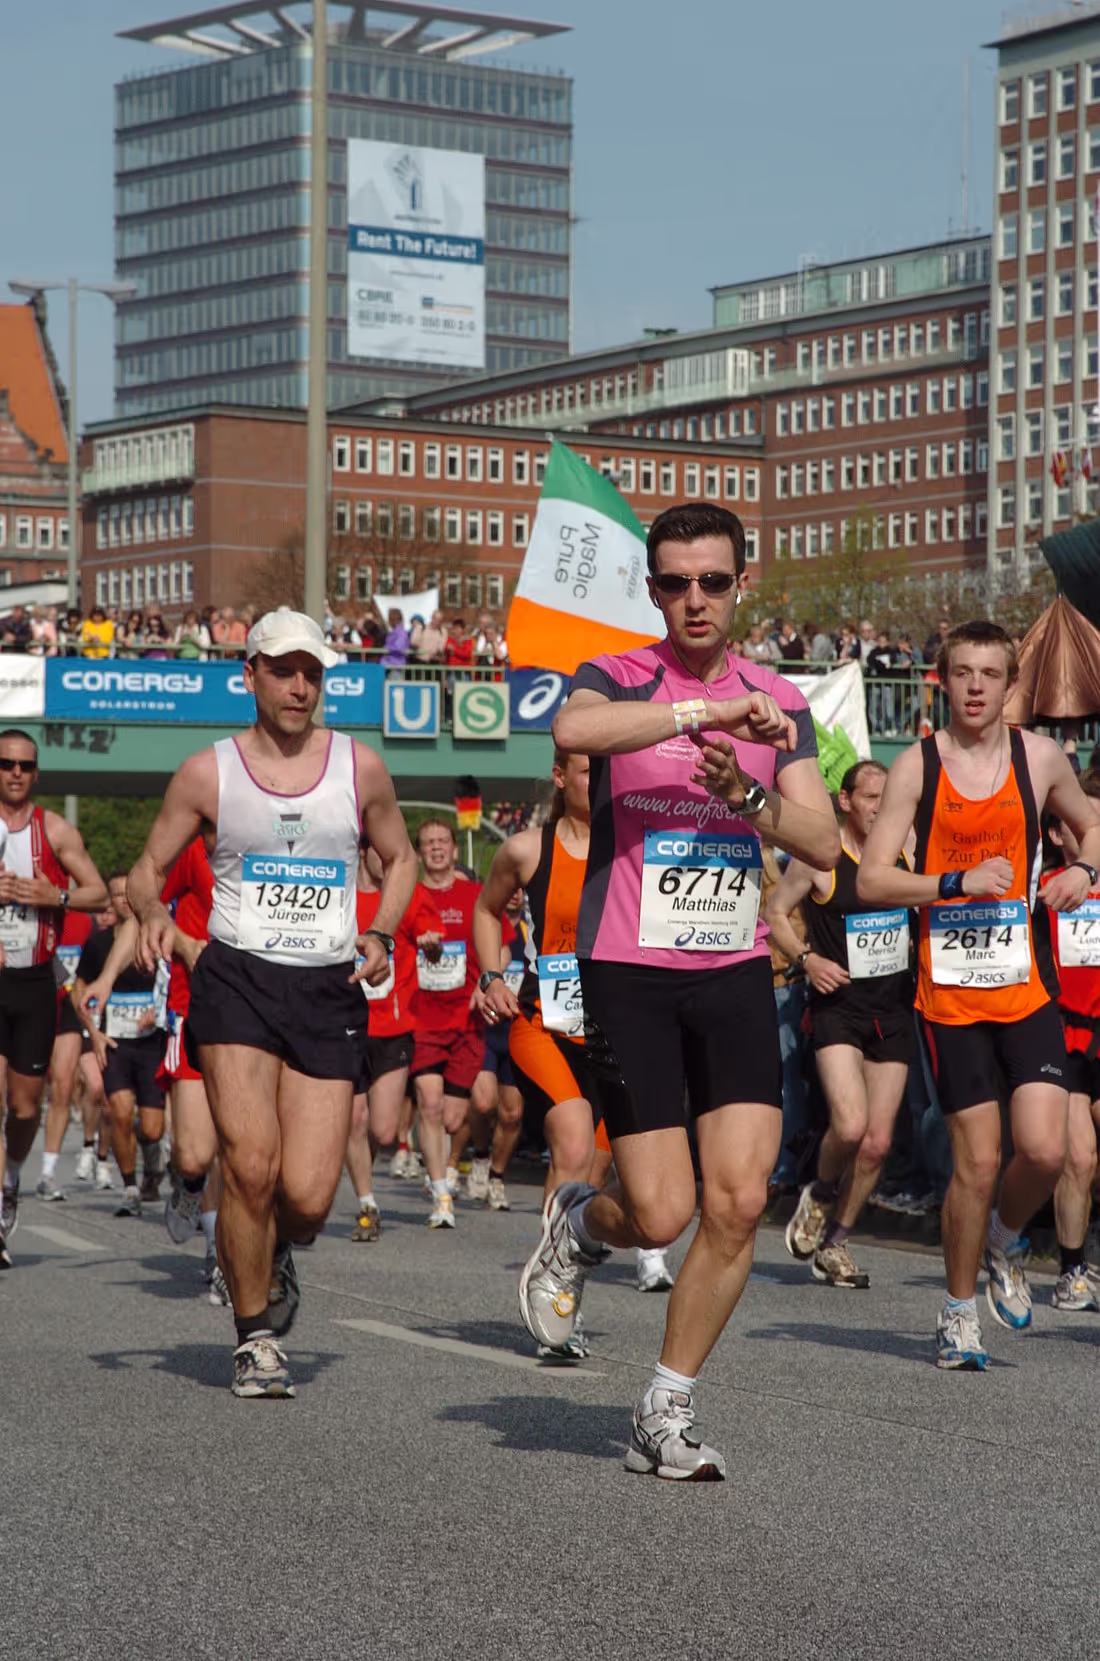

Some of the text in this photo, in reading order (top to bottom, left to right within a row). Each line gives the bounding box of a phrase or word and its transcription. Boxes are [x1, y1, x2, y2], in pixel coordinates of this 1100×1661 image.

[356, 230, 477, 259] Rent The Future!
[62, 671, 203, 693] CONERGY
[392, 687, 431, 730] U
[466, 692, 498, 728] S
[953, 826, 1006, 844] Gasthof
[658, 867, 746, 896] 6714
[256, 882, 331, 910] 13420
[672, 897, 737, 912] Matthias
[268, 909, 316, 924] Jürgen
[856, 928, 902, 949] 6707
[942, 925, 1013, 950] 2614
[868, 946, 897, 956] Derrick
[966, 950, 996, 961] Marc
